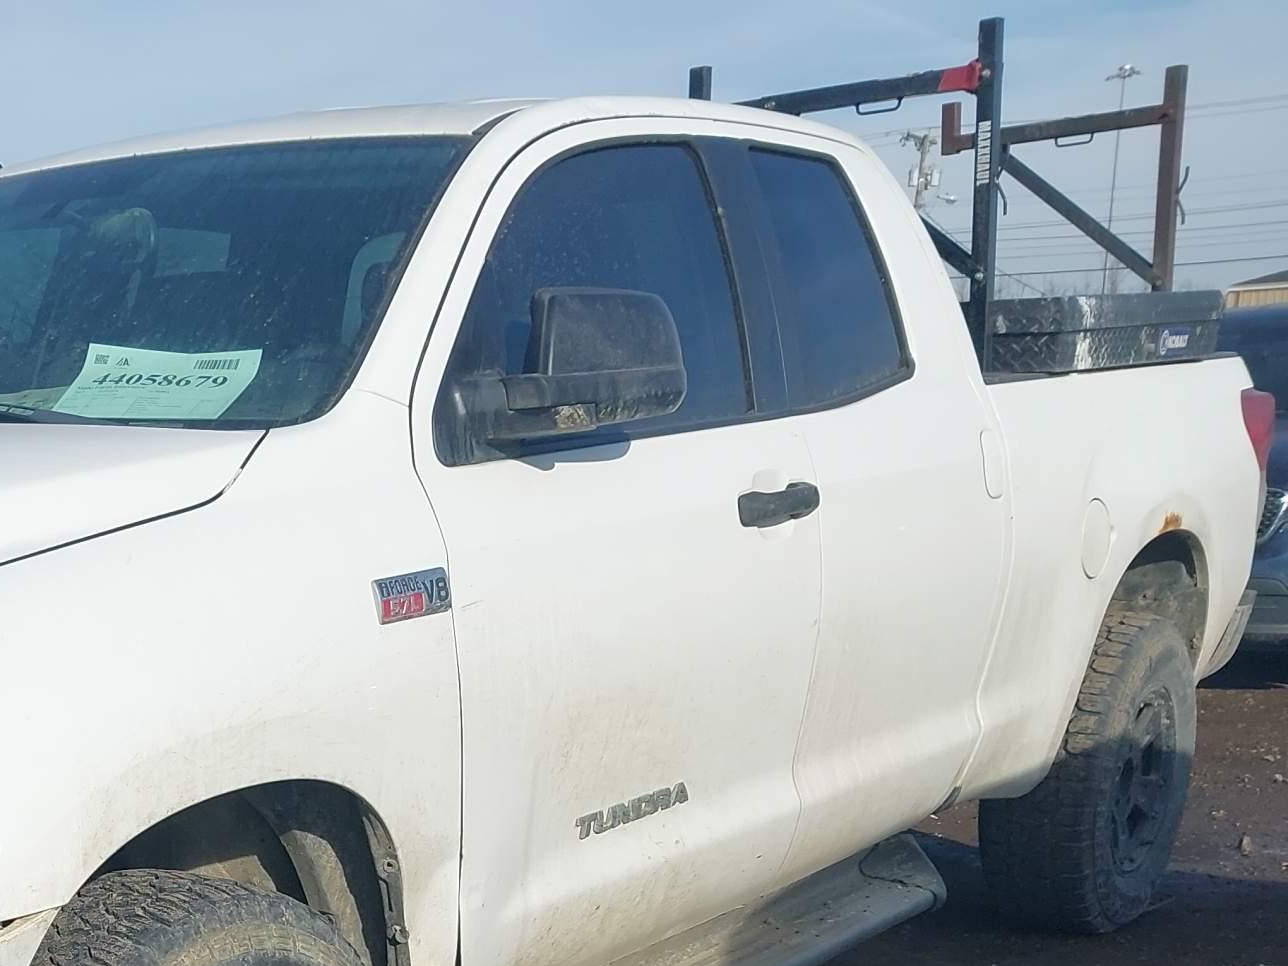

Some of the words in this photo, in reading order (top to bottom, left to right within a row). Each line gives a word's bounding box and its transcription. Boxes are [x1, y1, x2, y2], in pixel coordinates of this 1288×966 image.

[91, 372, 229, 389] 44058679
[421, 576, 450, 605] V8
[575, 781, 689, 840] TUNDRA
